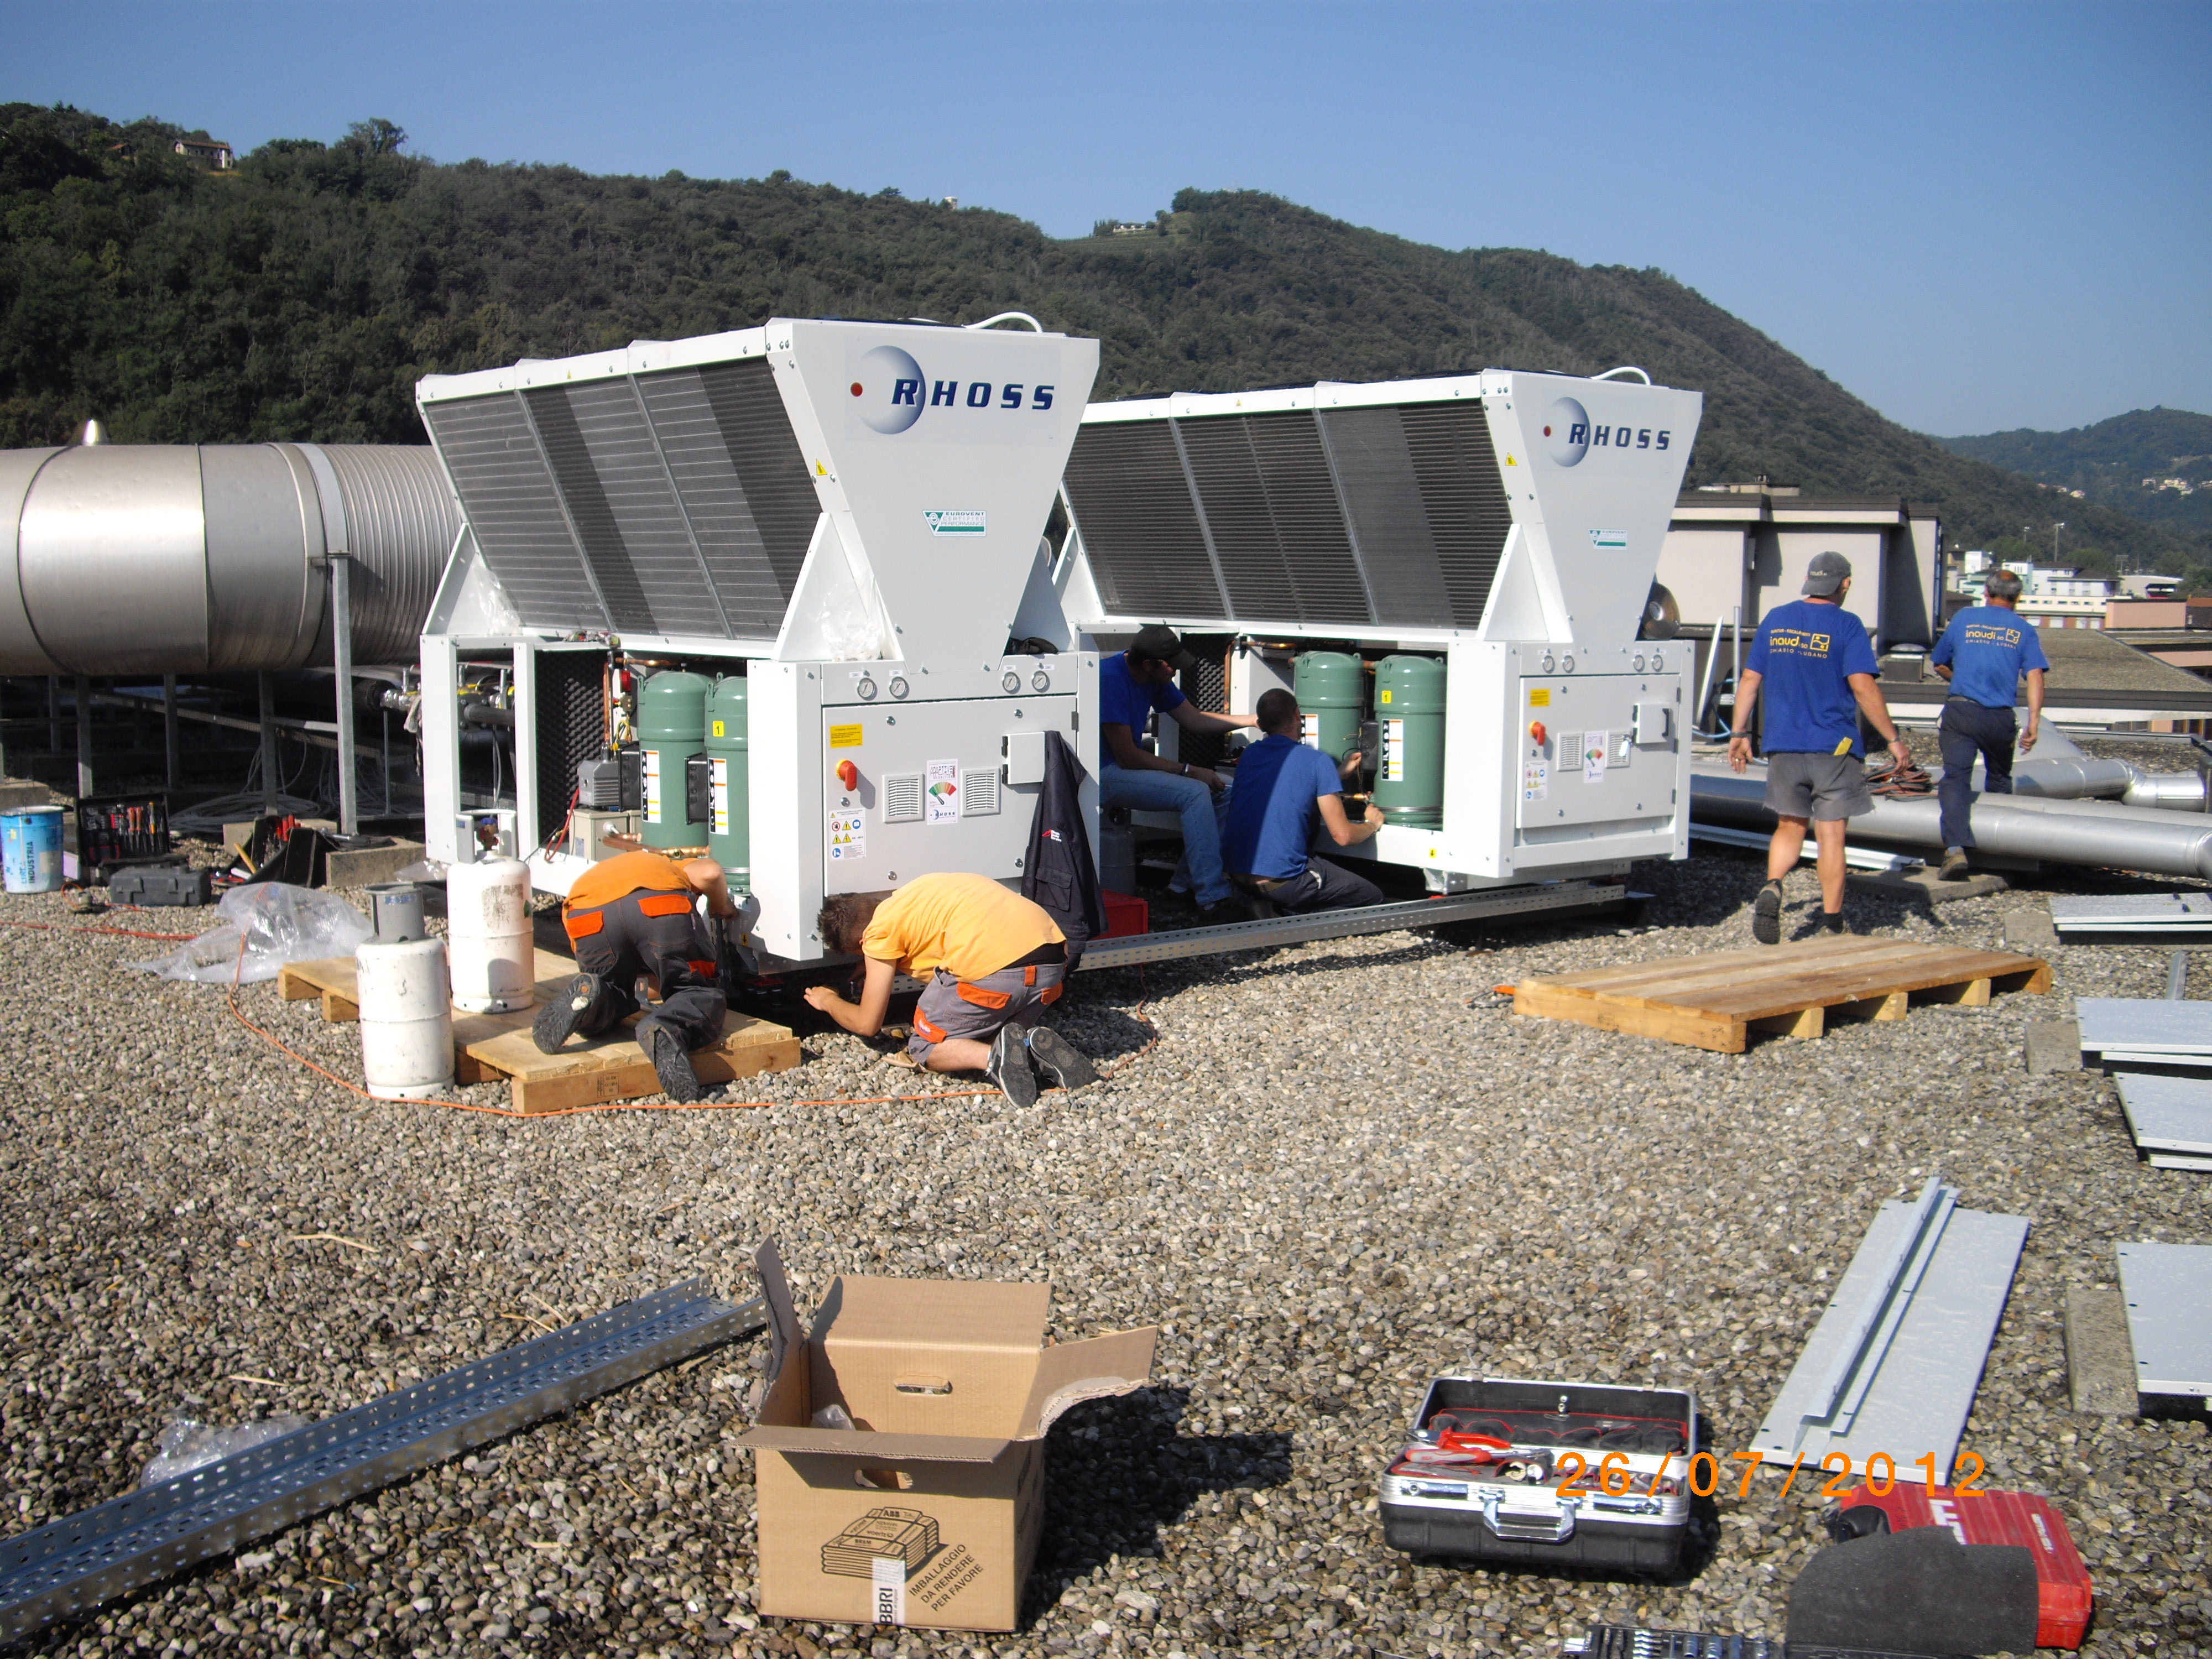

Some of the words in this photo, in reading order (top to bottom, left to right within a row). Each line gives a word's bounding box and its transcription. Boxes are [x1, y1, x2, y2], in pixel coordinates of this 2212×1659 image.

[891, 378, 1055, 410] RHOSS
[1568, 423, 1671, 450] RHOSS
[1770, 636, 1801, 647] inaud
[1965, 630, 1996, 639] inaudi
[716, 725, 719, 735] 1
[26, 841, 35, 884] INDUSTRIA
[909, 1544, 966, 1597] IMBALLAGGIO
[920, 1590, 936, 1603] DA
[933, 1554, 975, 1592] RENDERE
[931, 1593, 951, 1611] PER
[948, 1563, 984, 1595] FAVORE
